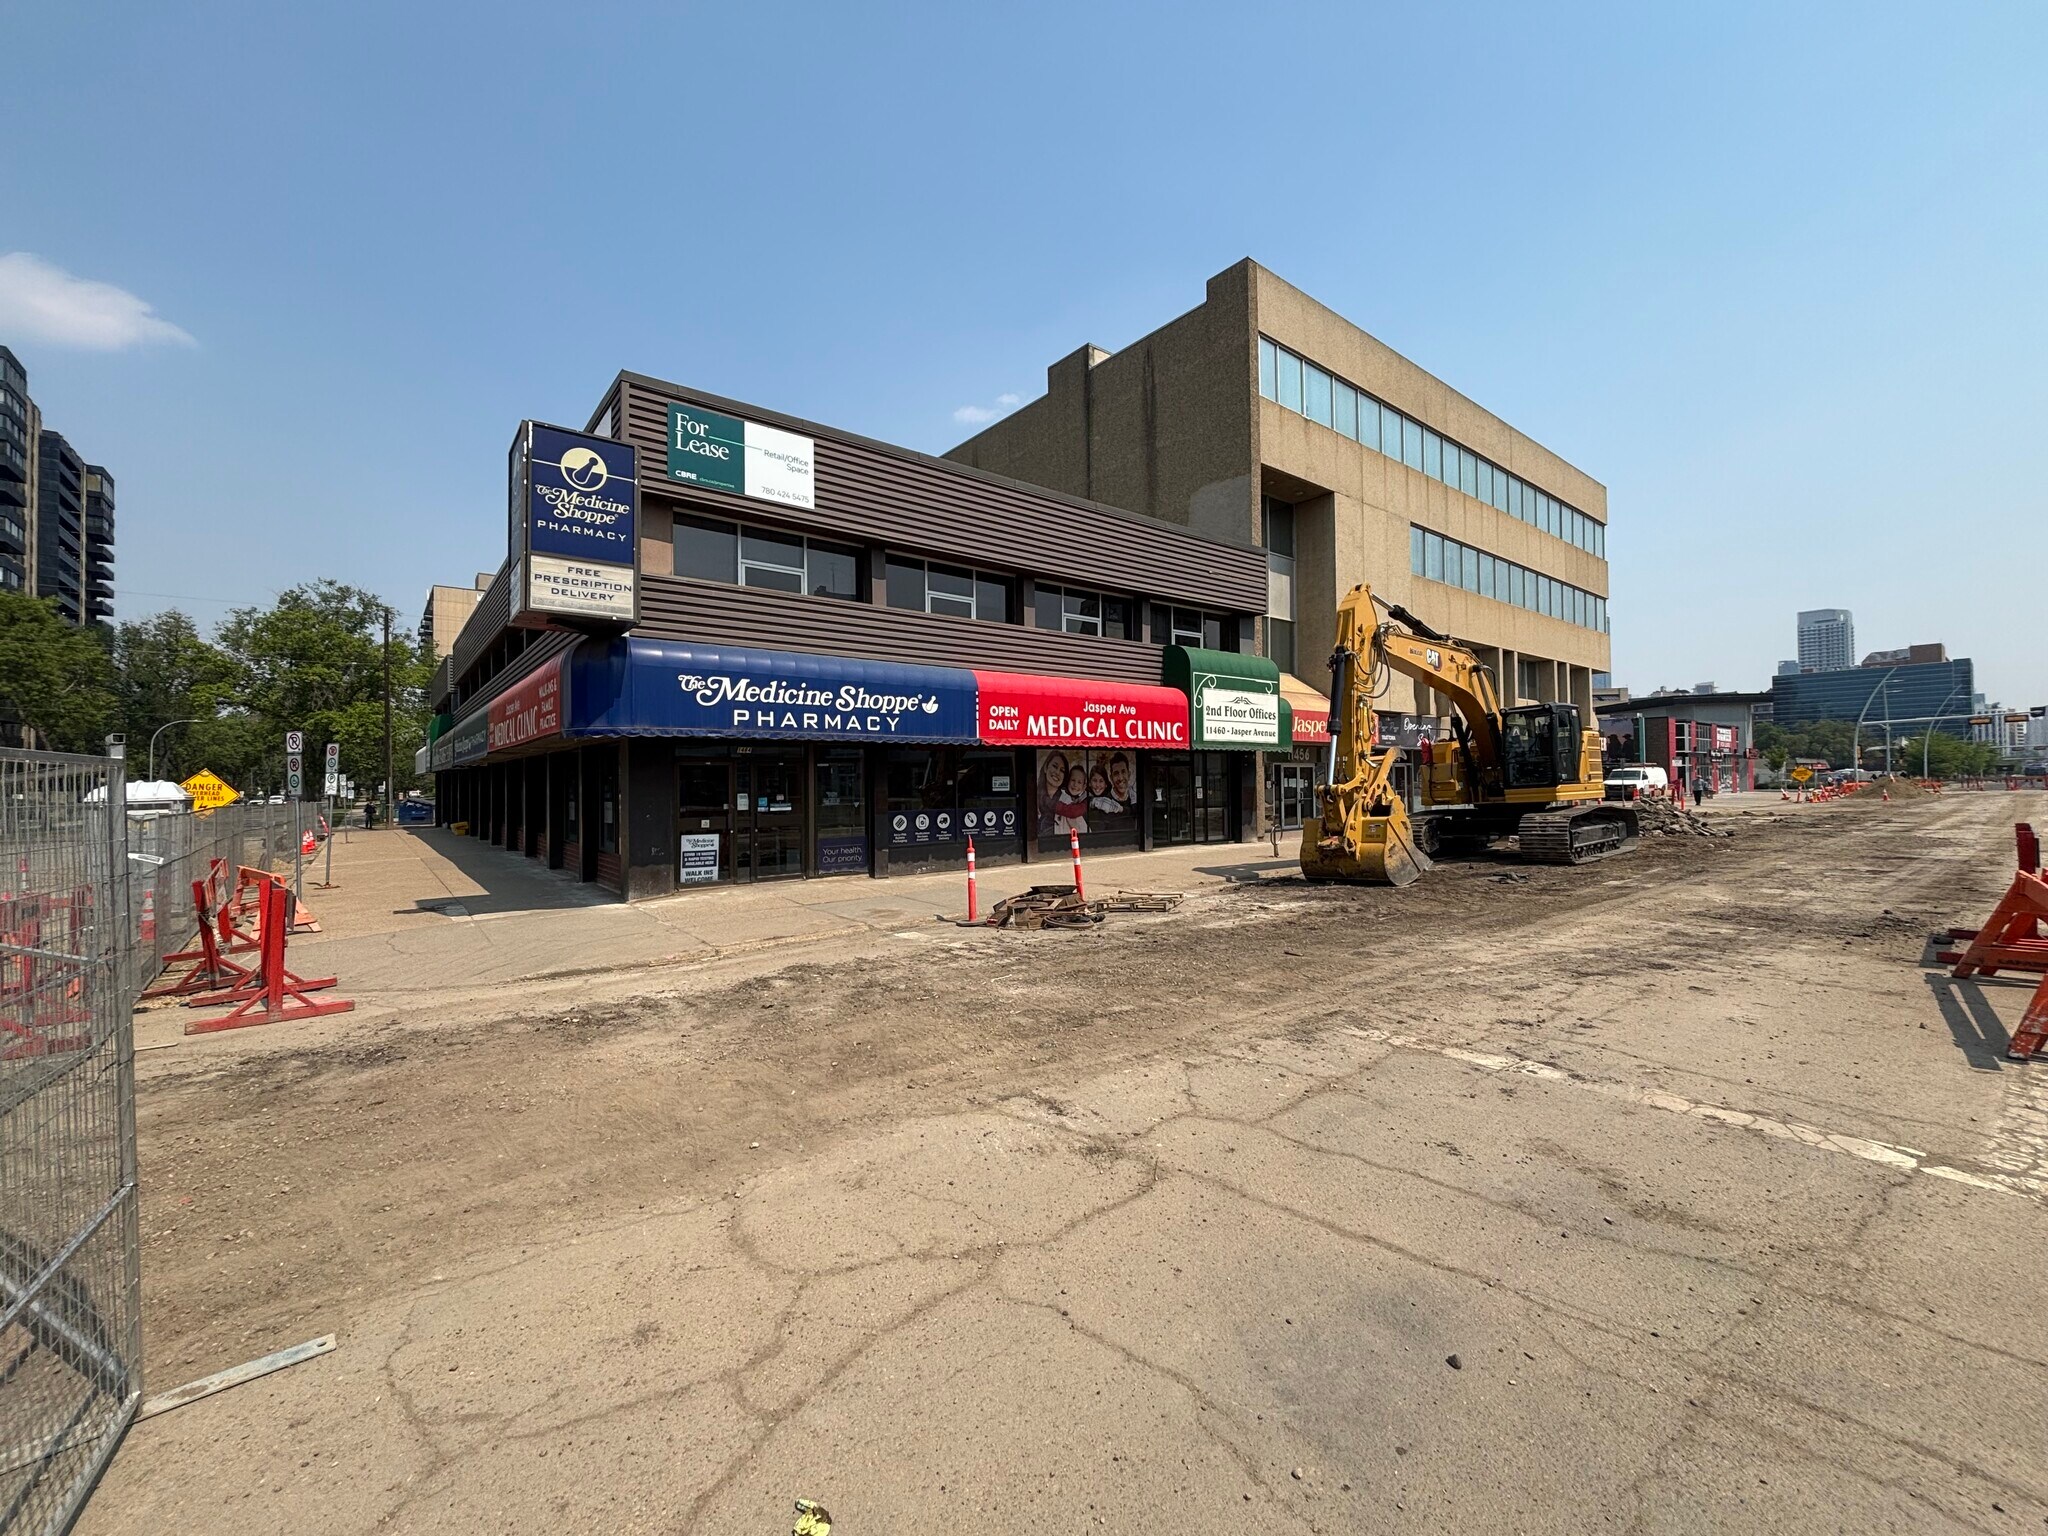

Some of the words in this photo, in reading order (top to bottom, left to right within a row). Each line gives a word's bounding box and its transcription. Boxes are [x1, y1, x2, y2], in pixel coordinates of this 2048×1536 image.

[675, 412, 709, 437] For
[675, 431, 730, 460] Lease
[764, 449, 809, 467] Retail/Office
[675, 470, 697, 480] CBRE
[786, 463, 809, 476] Space
[535, 484, 553, 495] The
[545, 487, 630, 514] Medicine
[762, 486, 775, 496] 780
[777, 490, 791, 499] 424
[792, 493, 810, 503] 5475
[553, 502, 616, 525] Shoppe
[537, 520, 626, 542] PHARMACY
[567, 566, 601, 578] FREE
[534, 573, 632, 592] PRESCRIPTION
[551, 587, 615, 601] DELIVERY
[1426, 648, 1440, 667] CAT
[678, 674, 706, 692] The
[696, 676, 833, 707] Medicine
[835, 685, 920, 714] Shoppe
[989, 706, 1019, 717] OPEN
[1083, 701, 1117, 716] Jasper
[1118, 704, 1137, 715] Ave
[1206, 705, 1222, 717] 2nd
[1224, 705, 1247, 718] Floor
[1249, 708, 1276, 720] Offices
[495, 717, 516, 746] MEDICAL
[517, 705, 538, 740] CLINIC
[733, 709, 900, 731] PHARMACY
[989, 718, 1020, 731] DAILY
[1026, 715, 1120, 738] MEDICAL
[1125, 719, 1184, 741] CLINIC
[1292, 716, 1327, 737] Jaspe
[1206, 726, 1226, 735] 11460
[1231, 727, 1252, 737] Jasper
[1253, 728, 1276, 737] Avenue
[186, 783, 223, 791] DANGER
[838, 854, 862, 863] priority
